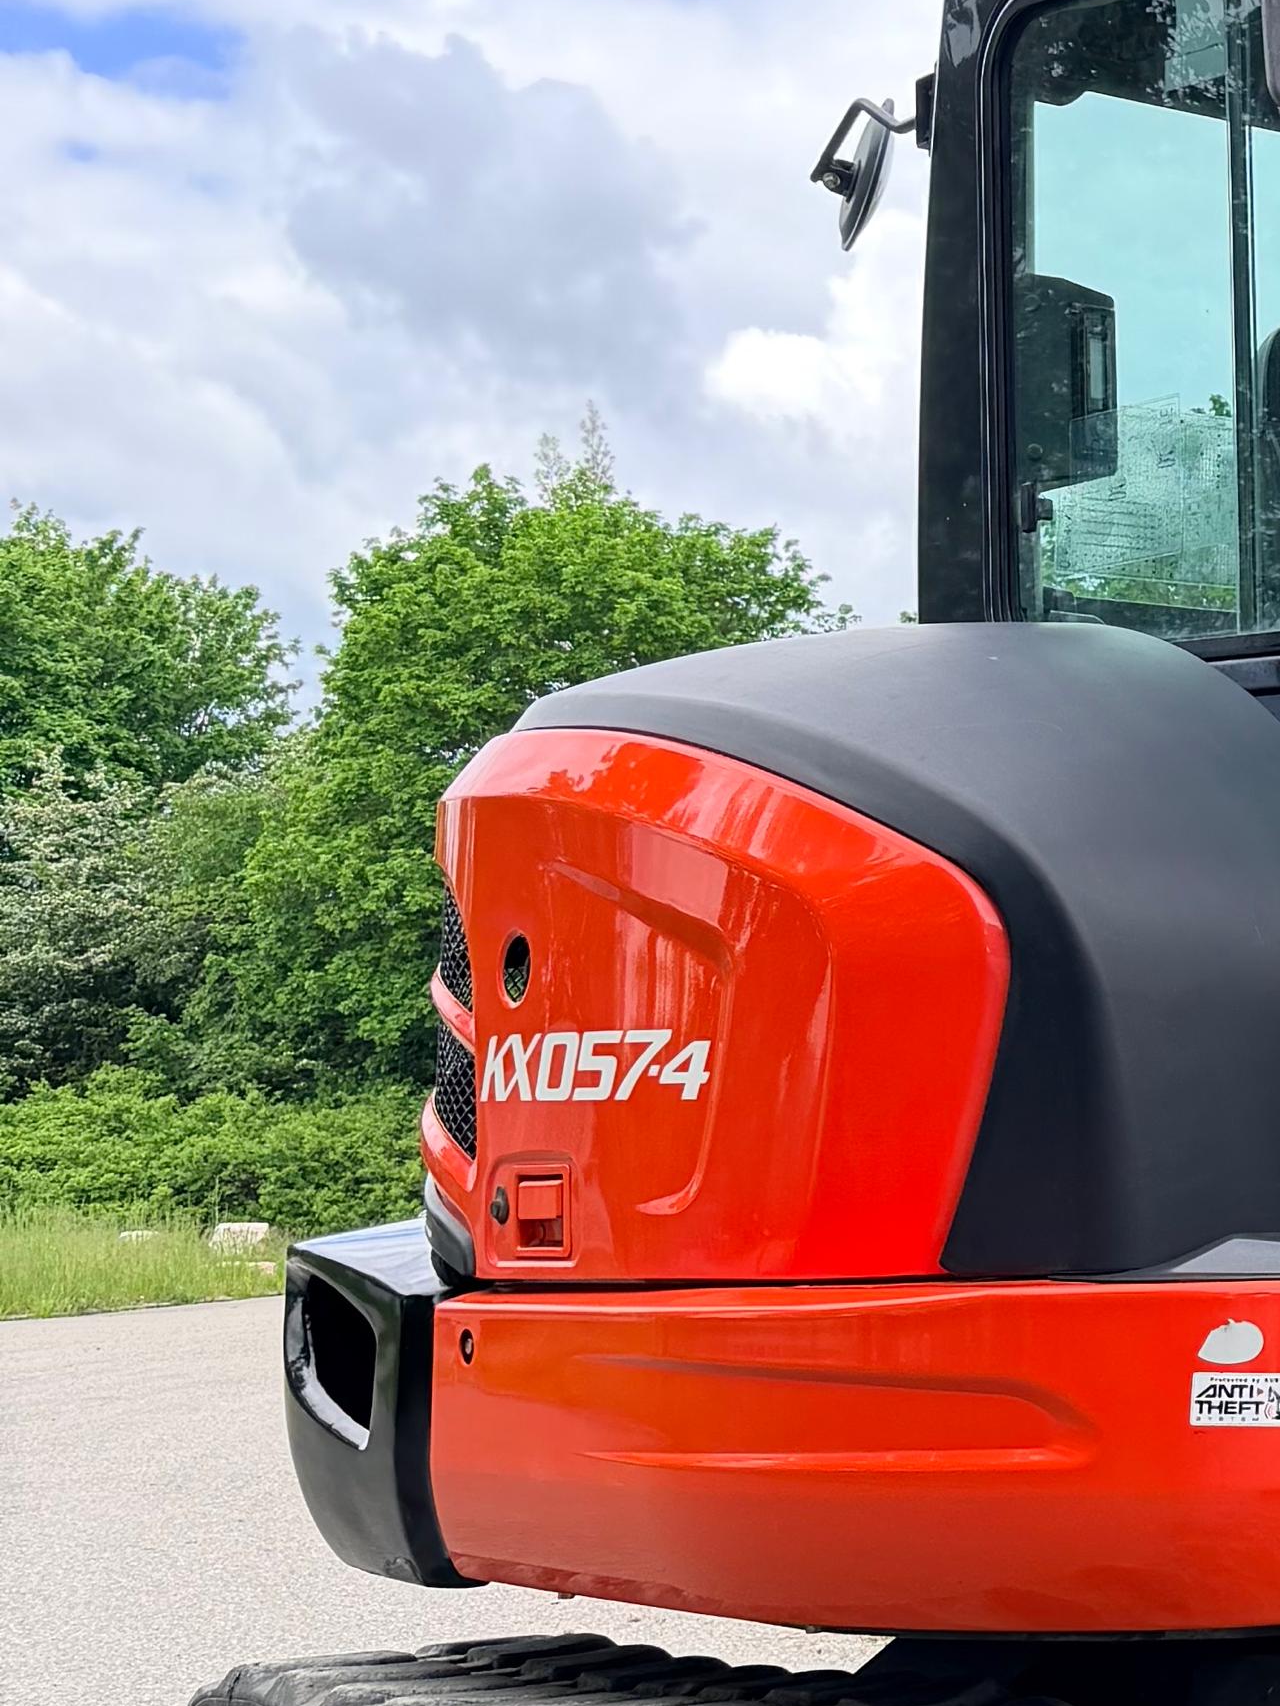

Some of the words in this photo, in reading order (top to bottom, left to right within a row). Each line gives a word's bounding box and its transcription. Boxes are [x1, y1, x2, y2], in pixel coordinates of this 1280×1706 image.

[480, 1028, 712, 1102] KX057-4
[1195, 1384, 1254, 1398] ANTI
[1194, 1400, 1265, 1415] THEFT
